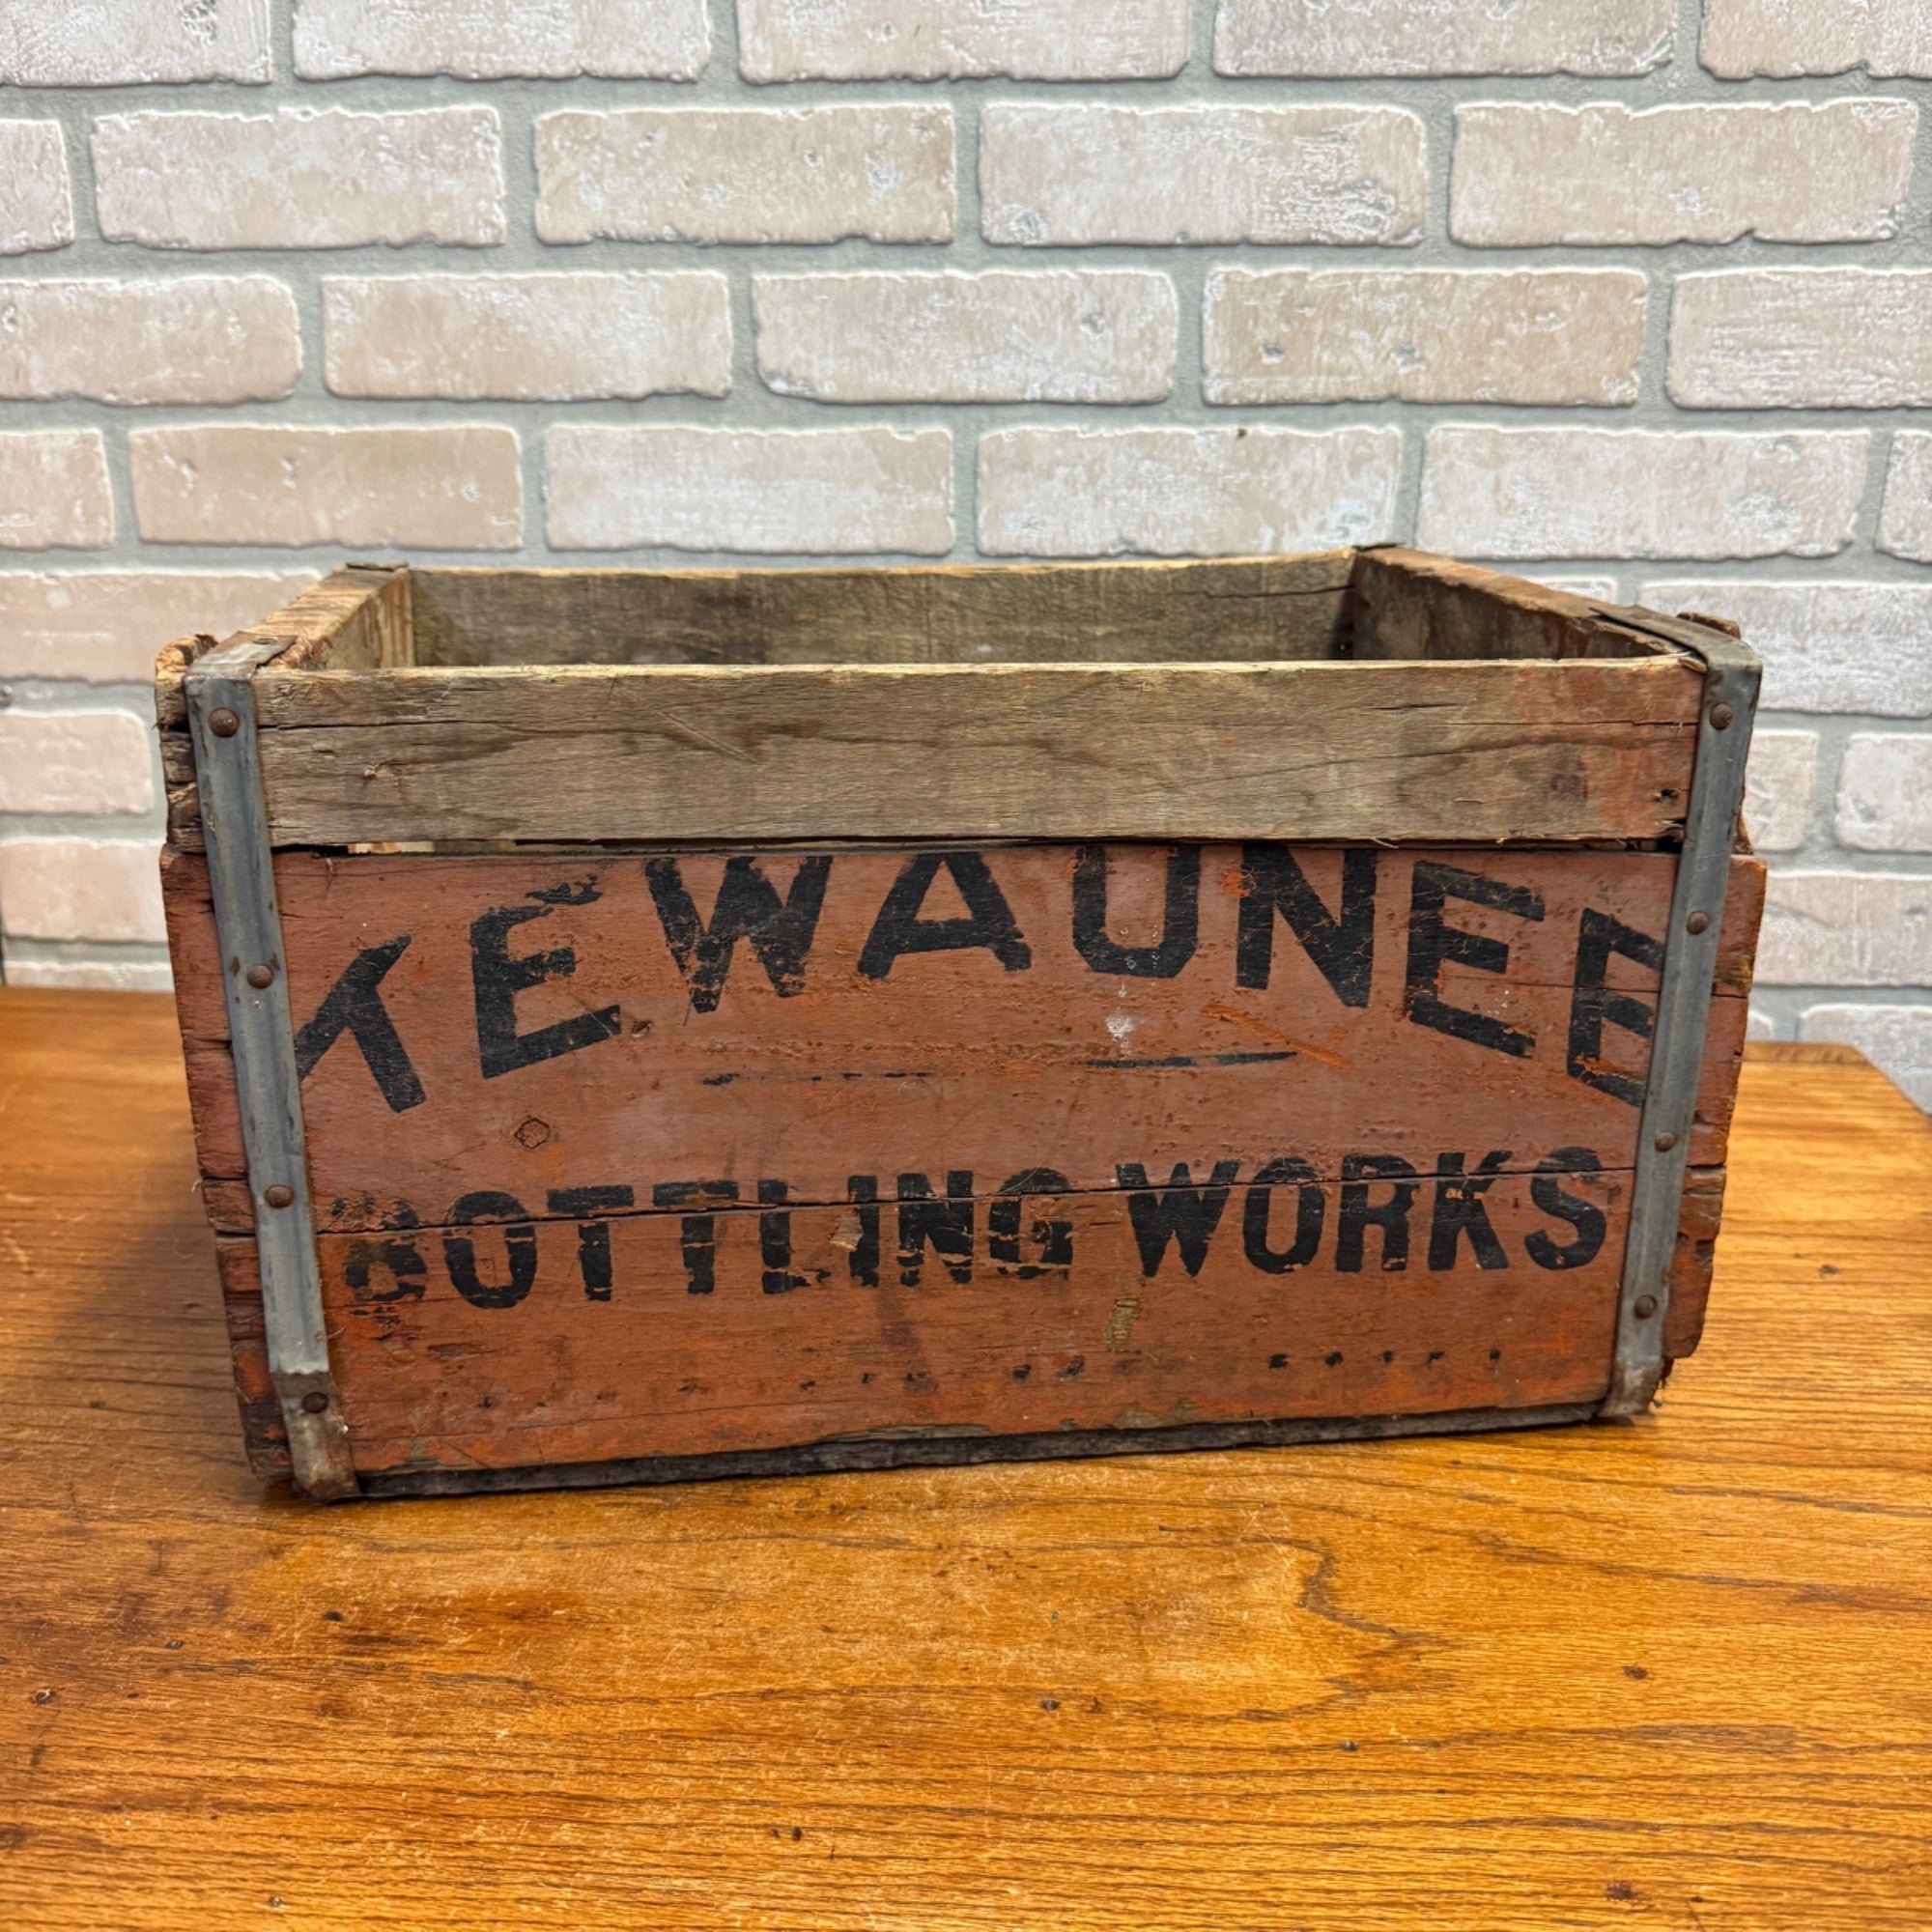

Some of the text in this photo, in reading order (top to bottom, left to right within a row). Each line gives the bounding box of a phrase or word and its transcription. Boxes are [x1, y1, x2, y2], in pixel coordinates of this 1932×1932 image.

[296, 845, 1666, 1112] KEWAUNEE
[330, 1147, 1606, 1309] BOTTLING WORKS
